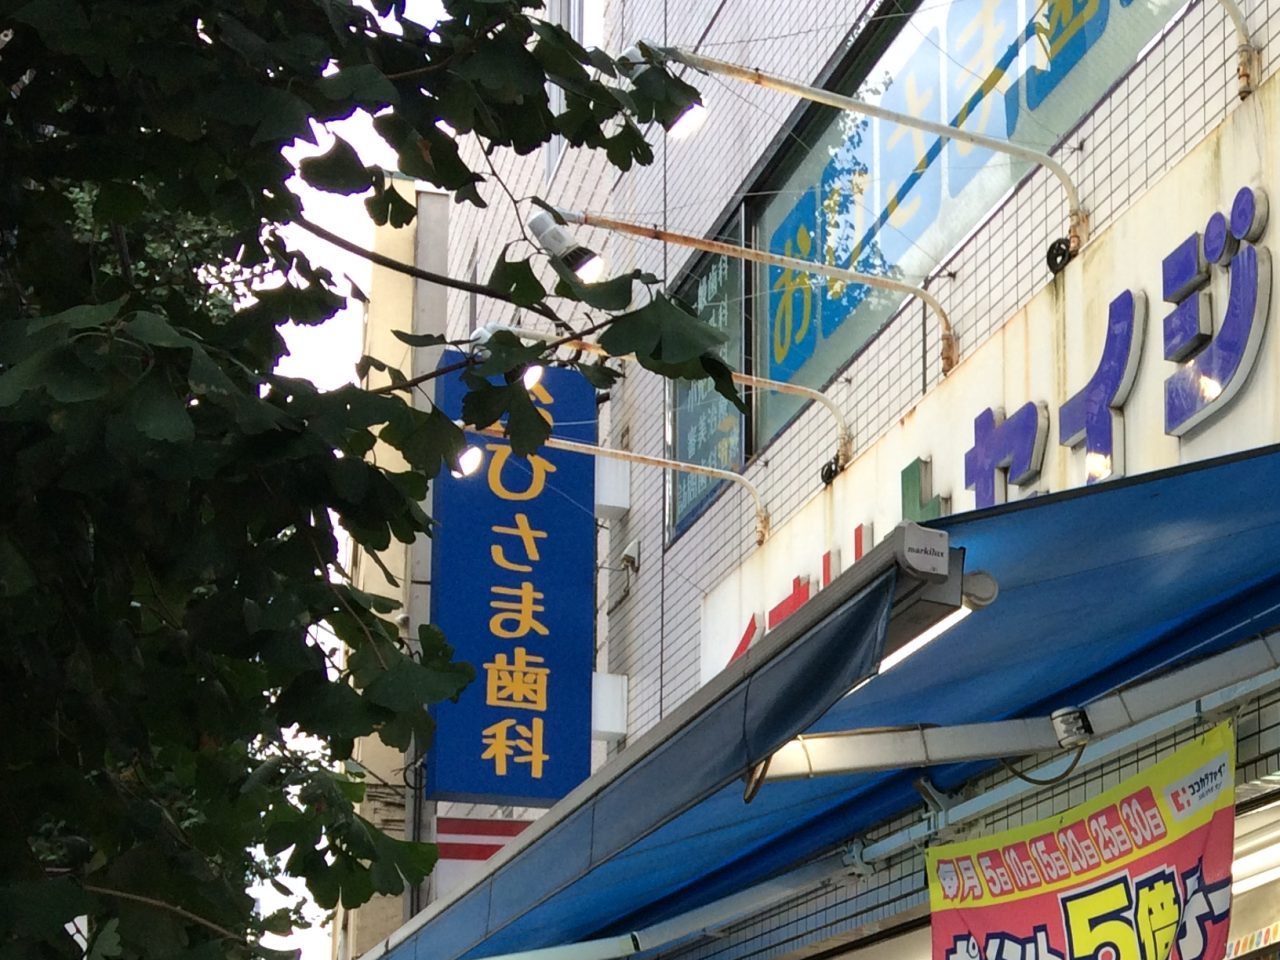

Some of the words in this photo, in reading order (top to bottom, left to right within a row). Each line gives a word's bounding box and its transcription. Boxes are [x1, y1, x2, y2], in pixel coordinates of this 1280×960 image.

[1188, 762, 1226, 796] ココカラファイ
[981, 853, 1010, 894] 5日
[1005, 848, 1038, 886] 10日
[1031, 839, 1067, 881] 15日
[1058, 826, 1100, 873] 20日
[1089, 812, 1132, 860] 25日
[1121, 796, 1166, 847] 30日
